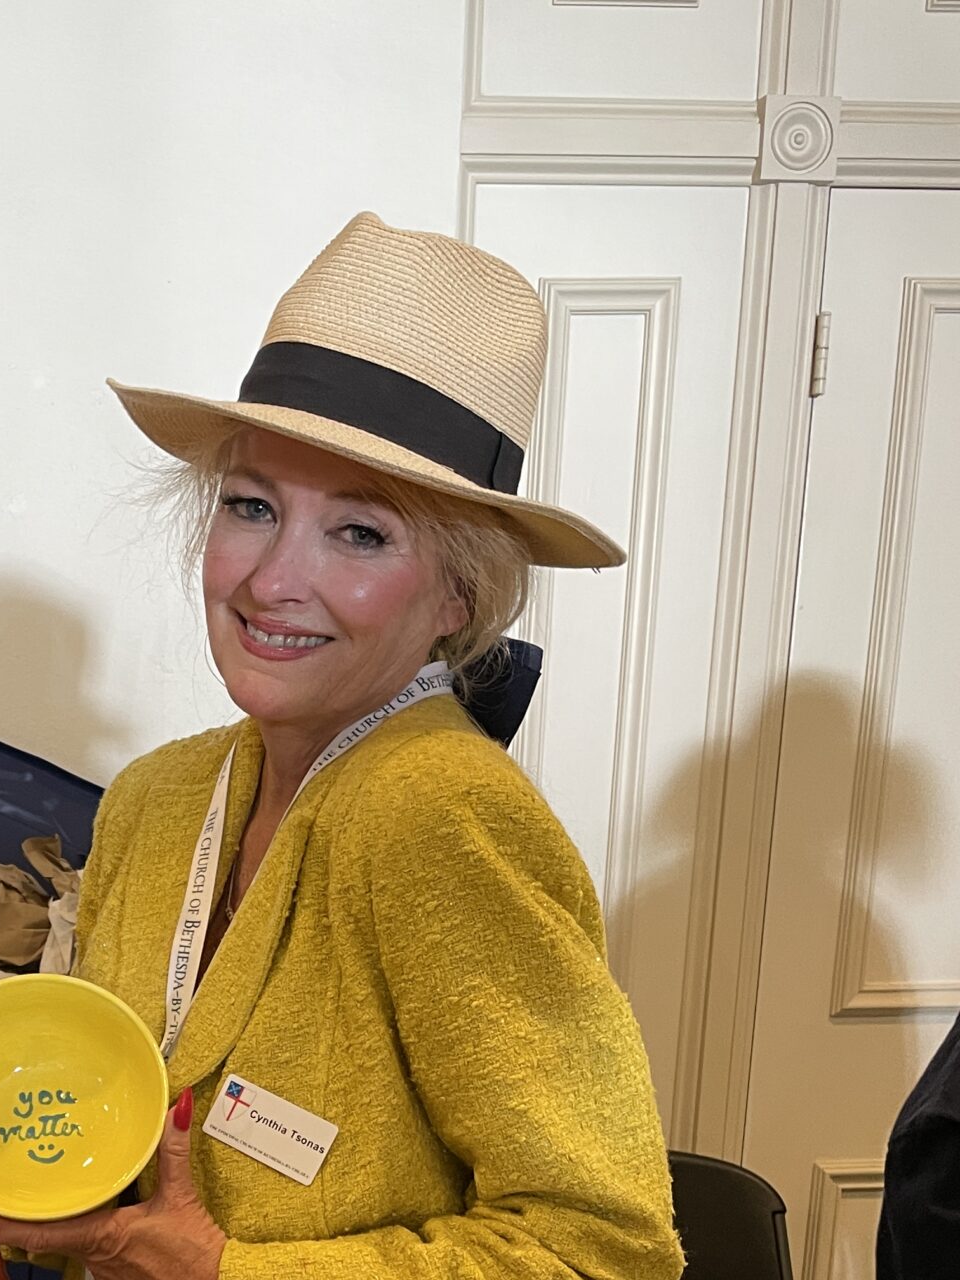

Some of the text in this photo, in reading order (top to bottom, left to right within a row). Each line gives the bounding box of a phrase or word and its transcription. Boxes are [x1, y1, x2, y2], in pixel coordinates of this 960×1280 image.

[338, 702, 396, 749] CHURCH
[396, 688, 416, 704] OF
[202, 807, 219, 835] THE
[191, 837, 212, 894] CHURCH
[187, 898, 201, 916] OF
[13, 1089, 78, 1118] you
[249, 1109, 326, 1155] Cynthia Tsonas
